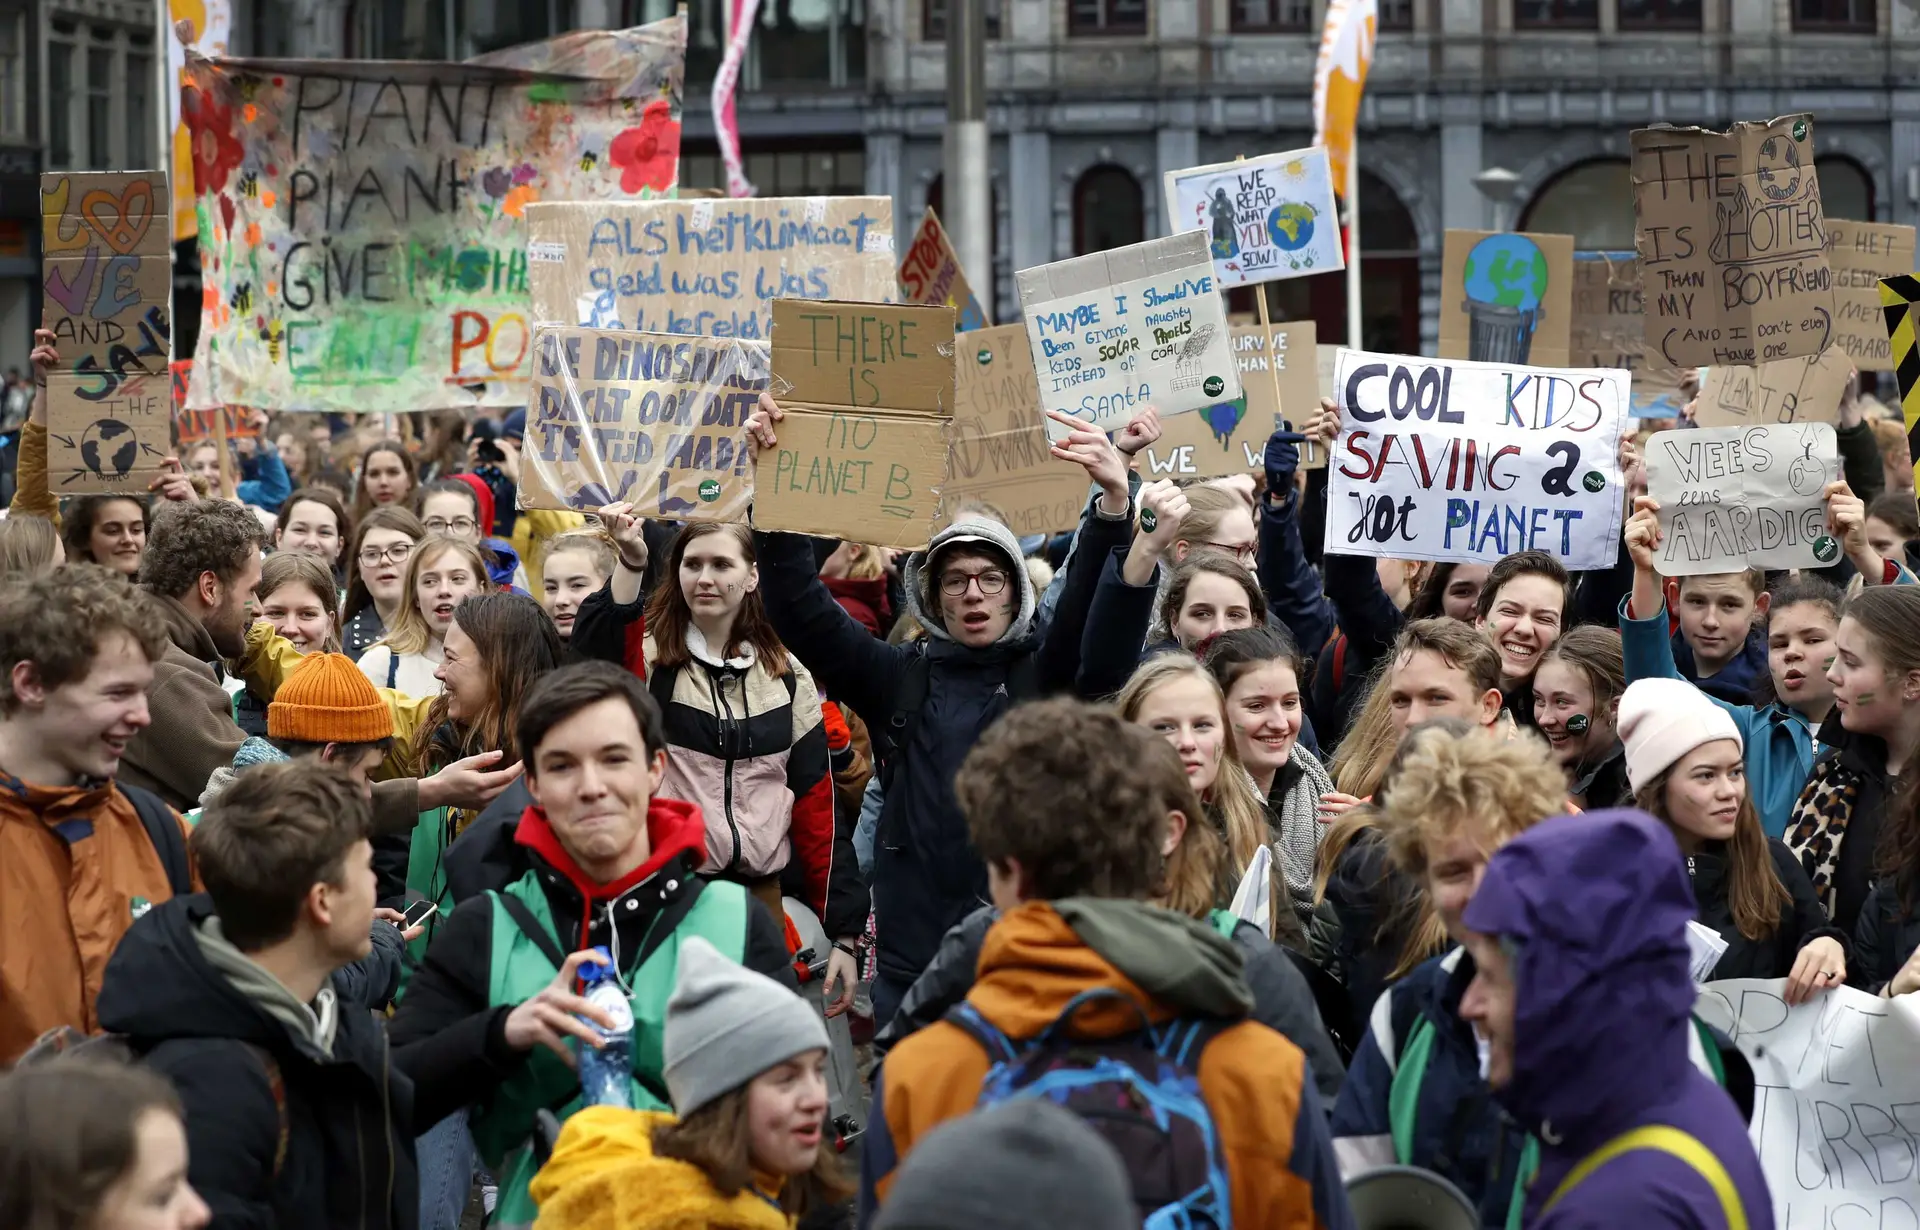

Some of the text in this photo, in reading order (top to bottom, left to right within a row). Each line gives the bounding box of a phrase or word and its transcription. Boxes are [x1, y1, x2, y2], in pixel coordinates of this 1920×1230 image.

[1238, 169, 1268, 192] WE
[1638, 144, 1737, 202] THE
[1236, 187, 1276, 212] REAP
[1236, 207, 1266, 225] WHAT
[588, 216, 669, 258] ALS
[1238, 220, 1268, 250] YOU
[1645, 201, 1824, 266] IS HOTTER
[1855, 231, 1897, 257] HET
[282, 237, 394, 311] GiVE
[901, 219, 944, 300] STOP
[589, 262, 665, 312] geld
[1657, 270, 1705, 291] THAN
[1658, 262, 1831, 320] MY BOYFRiEND
[53, 317, 125, 347] AND
[1036, 303, 1101, 336] MAYBE
[1115, 295, 1128, 316] I
[1729, 328, 1747, 340] I
[1757, 320, 1793, 337] Don't
[1838, 300, 1884, 323] MET
[74, 306, 170, 400] SAVE
[541, 334, 582, 378] DE
[800, 314, 918, 367] THERE
[1041, 338, 1075, 358] Been
[1085, 324, 1128, 345] GIVInG
[1050, 356, 1083, 375] KIDS
[1098, 337, 1141, 362] SOLAR
[1232, 332, 1288, 350] URVVE
[1714, 349, 1757, 366] Have
[850, 366, 881, 407] IS
[1052, 345, 1180, 393] InstEAD of COAL
[97, 397, 159, 418] THE
[538, 386, 759, 428] DAChT OoK DAT
[1345, 363, 1605, 432] COOL KIDS
[826, 412, 877, 450] nO
[775, 450, 912, 500] PLANET B
[1146, 446, 1197, 474] WE
[1339, 431, 1522, 492] SAVING
[1664, 427, 1774, 484] WEES
[1347, 491, 1419, 544] Hot
[1676, 489, 1721, 508] eens
[1664, 506, 1824, 562] AARDIG
